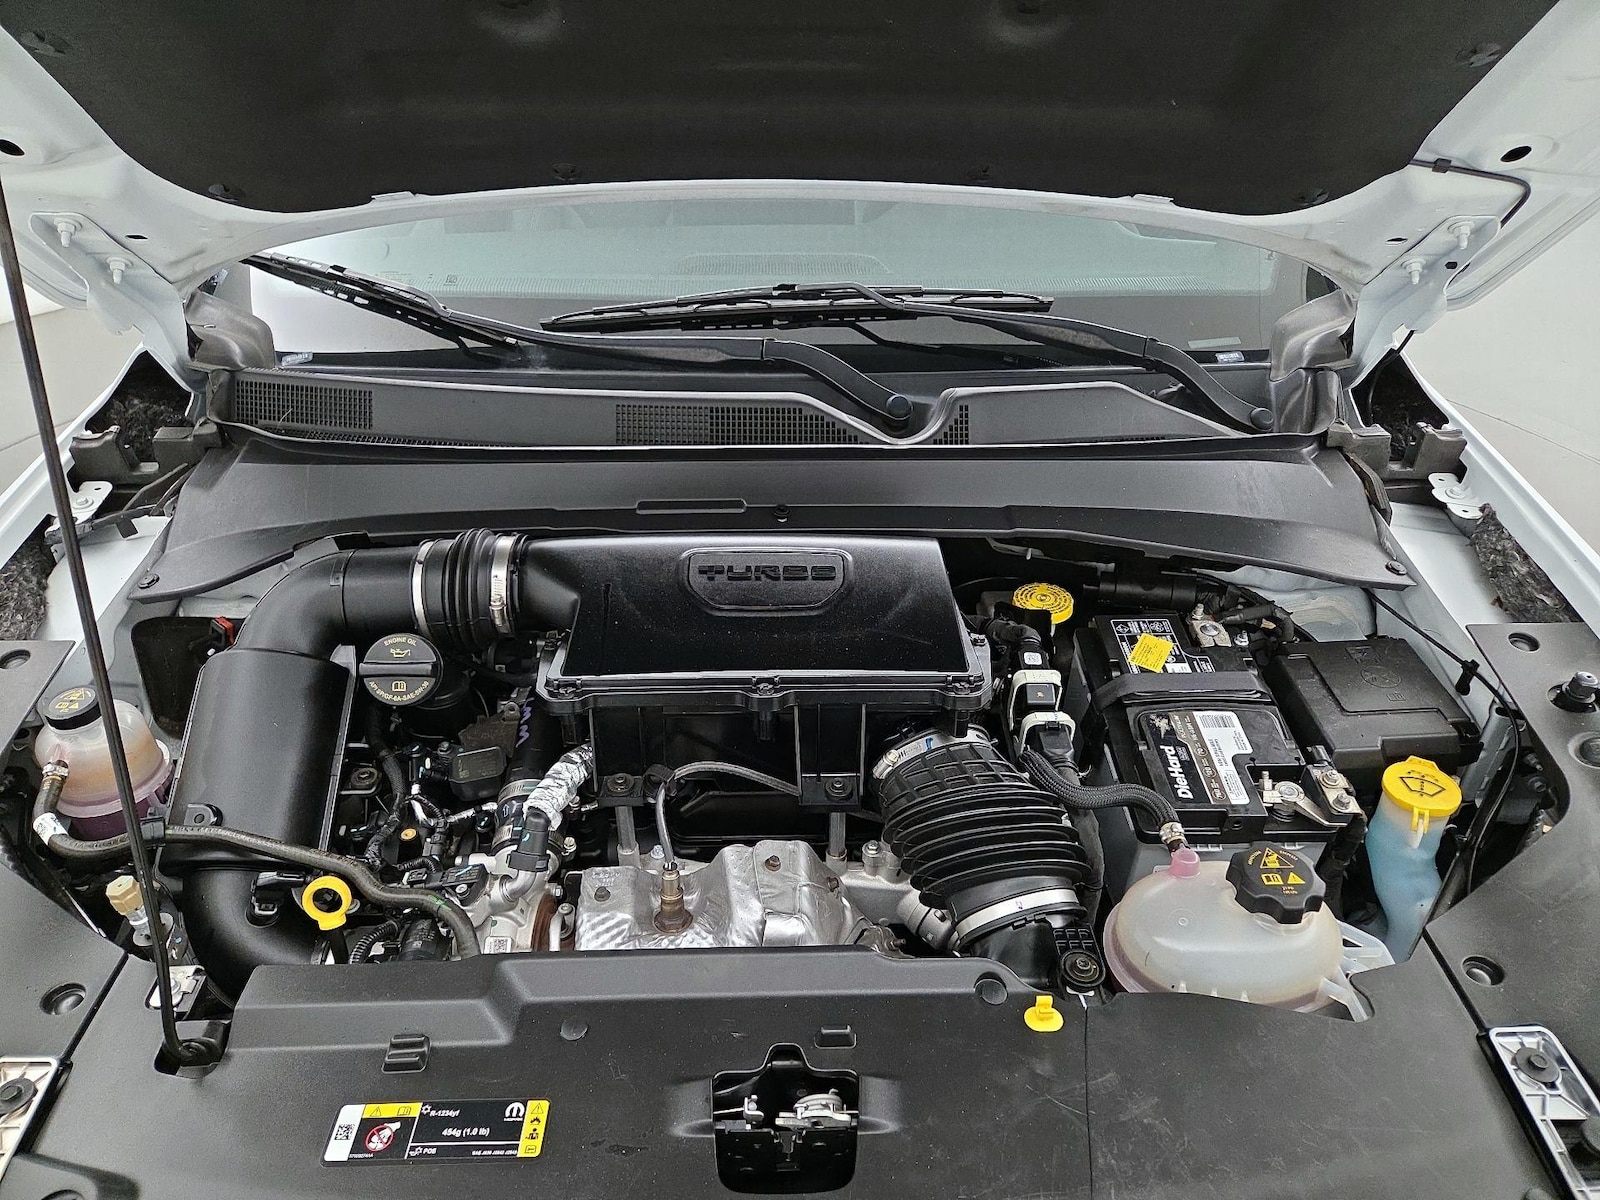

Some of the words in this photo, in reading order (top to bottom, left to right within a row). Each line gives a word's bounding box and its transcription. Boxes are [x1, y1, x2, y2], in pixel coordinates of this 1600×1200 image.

[698, 565, 836, 581] TURBO
[384, 637, 406, 646] ENGINE
[407, 637, 417, 646] OIL
[1160, 745, 1194, 799] DieHard
[442, 1128, 462, 1137] 454g
[463, 1128, 478, 1137] (1.0
[479, 1127, 490, 1136] lb)
